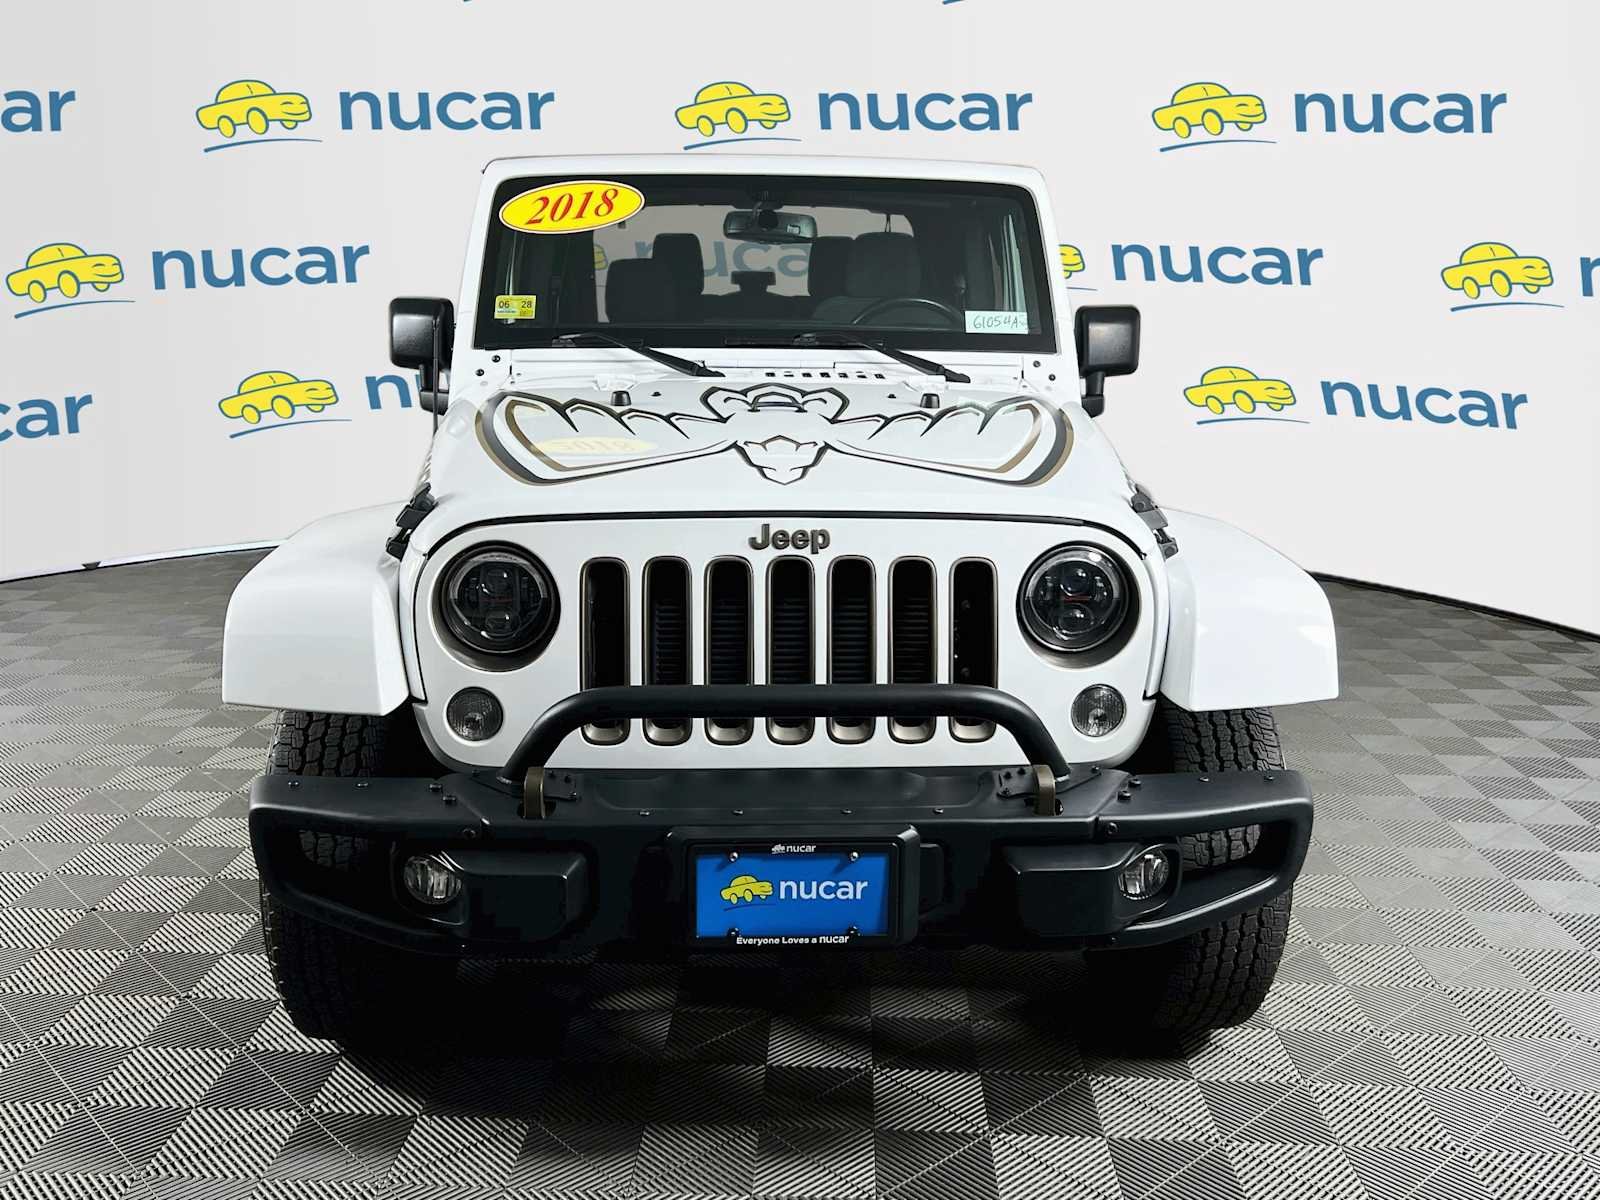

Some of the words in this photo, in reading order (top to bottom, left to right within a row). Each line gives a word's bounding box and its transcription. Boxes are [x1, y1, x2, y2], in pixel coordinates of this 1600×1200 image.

[339, 91, 555, 131] nucar
[818, 92, 1033, 132] nucar
[1295, 93, 1507, 134] nucar
[525, 188, 619, 225] 2018
[152, 244, 369, 290] nucar
[1111, 244, 1323, 286] nucar
[1321, 380, 1528, 430] nucar
[748, 523, 831, 554] Jeep
[786, 845, 817, 853] nucar
[779, 879, 868, 900] nucar
[736, 936, 780, 946] Everyone
[782, 936, 809, 944] Loves
[819, 935, 850, 944] nucar
